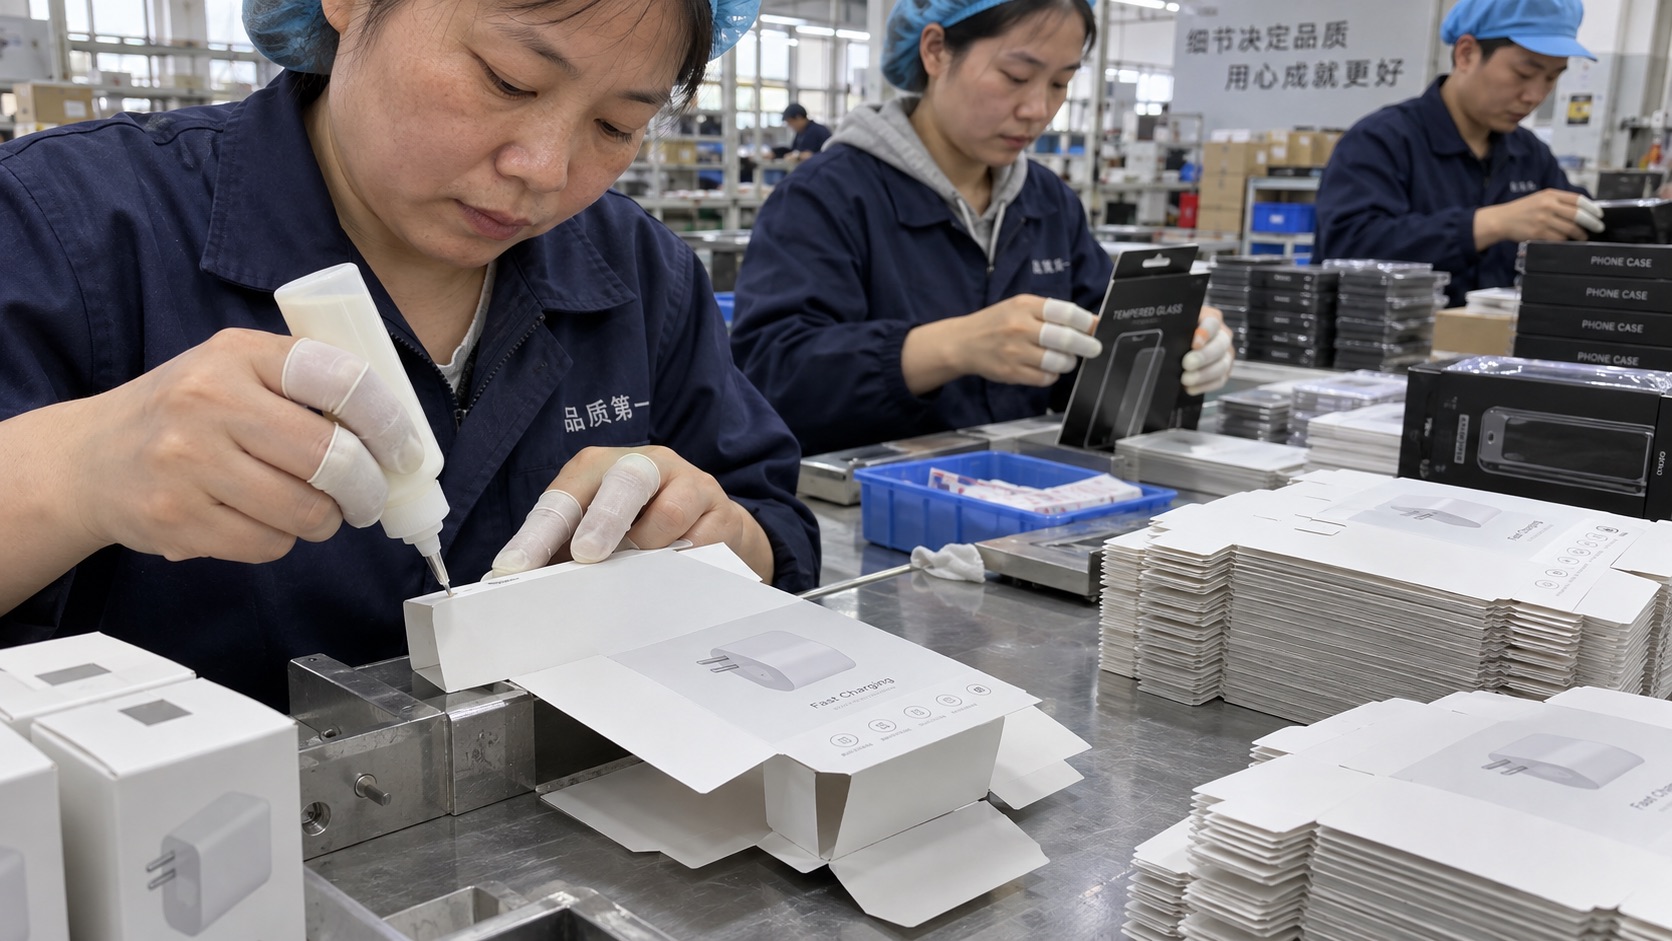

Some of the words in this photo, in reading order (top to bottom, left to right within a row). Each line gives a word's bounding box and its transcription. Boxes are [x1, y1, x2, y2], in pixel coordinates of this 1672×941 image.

[1186, 20, 1349, 54] 细节决定品质
[1225, 58, 1404, 91] 用心成就更好
[1590, 255, 1624, 267] PHONE
[1626, 257, 1653, 268] CASE
[1586, 287, 1620, 299] PHONE
[1622, 289, 1648, 301] CASE
[1113, 306, 1156, 321] TEMPERED
[1156, 303, 1183, 316] GLASS
[1581, 319, 1615, 331] PHONE
[1617, 322, 1645, 333] CASE
[1577, 351, 1611, 364] PHONE
[1613, 355, 1640, 366] CASE
[564, 394, 650, 433] 品质第一
[810, 696, 840, 709] Fast
[839, 677, 895, 699] Charging
